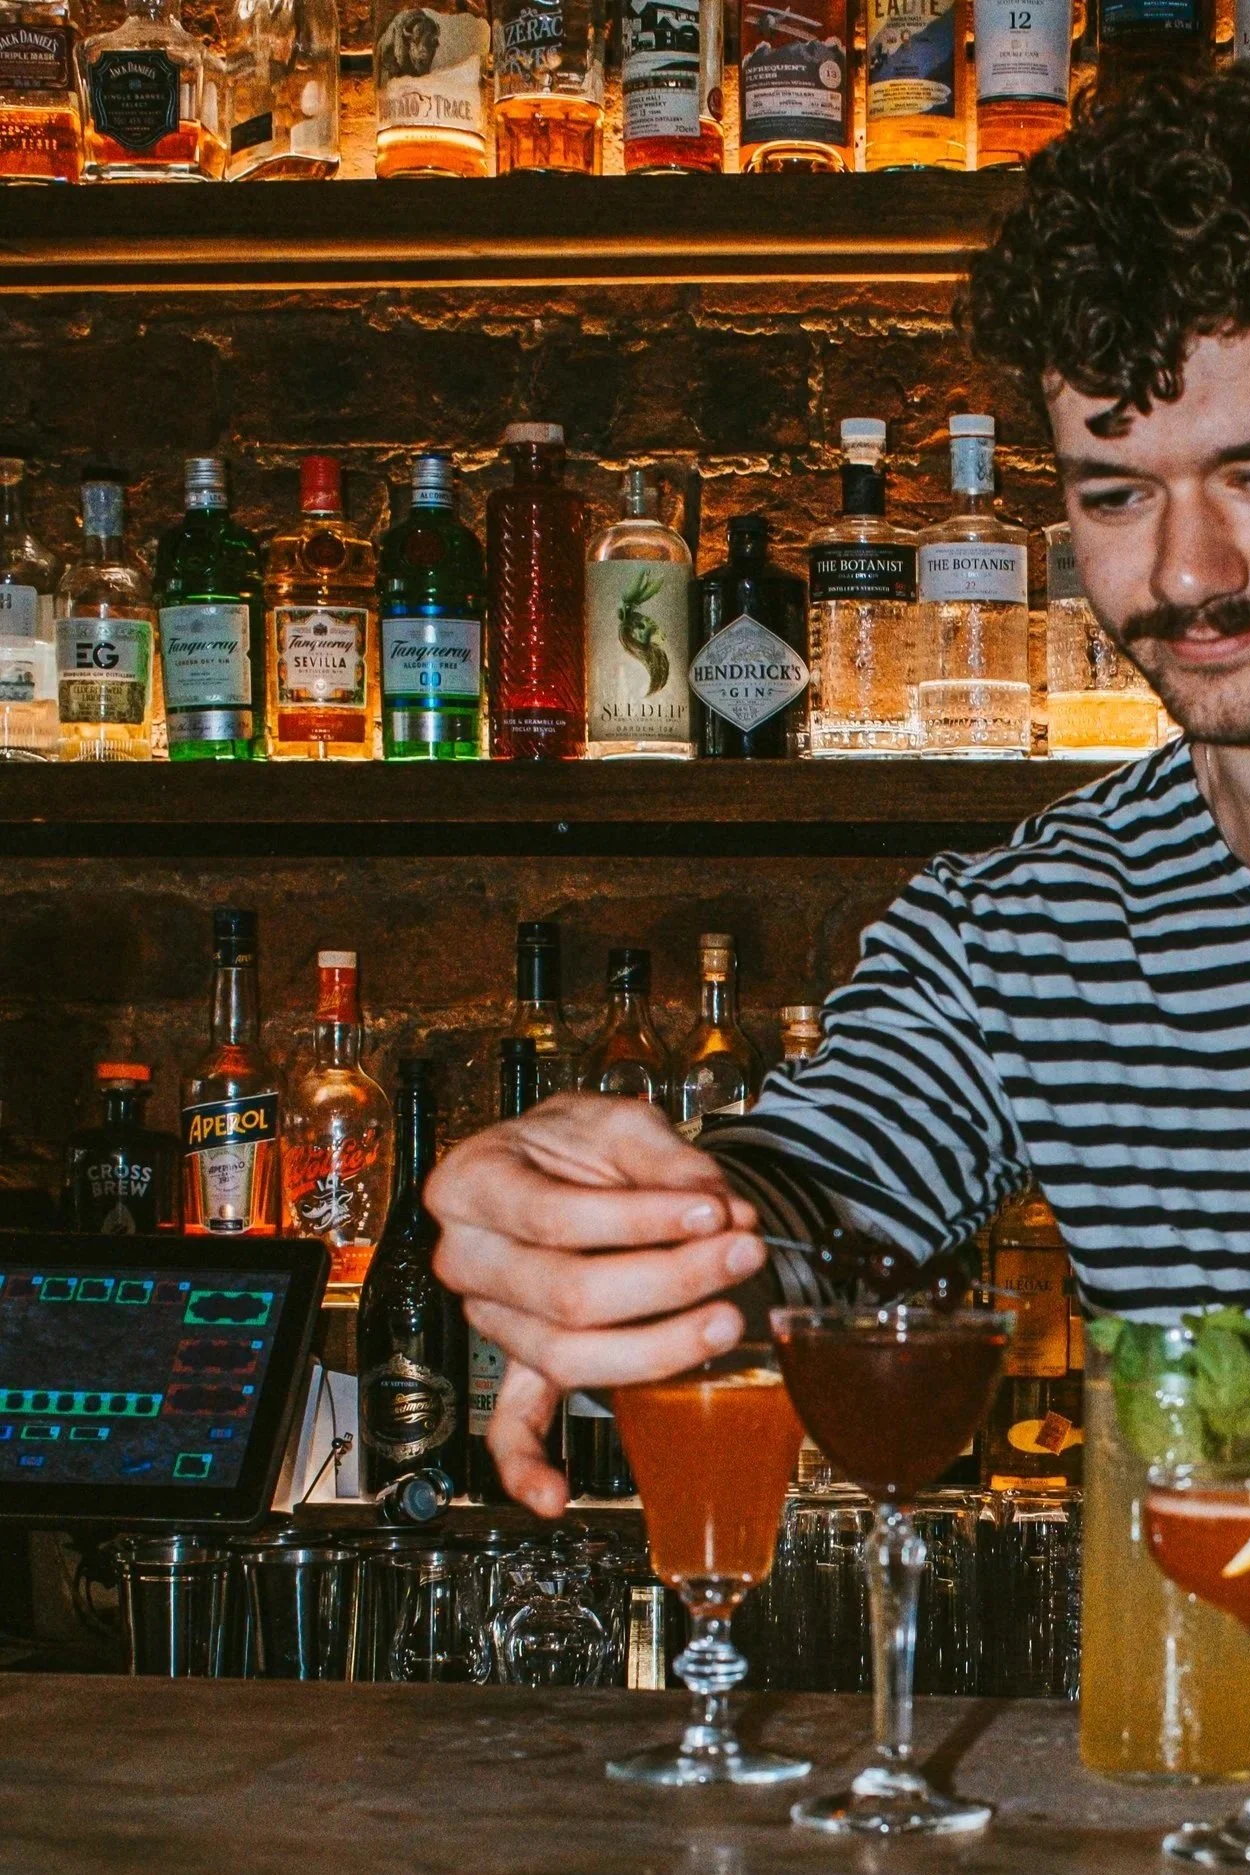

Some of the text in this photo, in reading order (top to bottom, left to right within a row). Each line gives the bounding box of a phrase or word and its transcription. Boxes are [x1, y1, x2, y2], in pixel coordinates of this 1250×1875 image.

[1009, 11, 1032, 29] 12
[0, 29, 59, 53] ACK DANIEL'S
[31, 52, 55, 60] MASH
[433, 94, 474, 120] TRACE
[816, 559, 904, 573] THE BOTANIST
[928, 557, 1016, 572] THE BOTANIST
[168, 637, 239, 656] Tanqueray
[288, 634, 354, 653] Tanqueray
[390, 640, 472, 663] Tanqueray
[76, 642, 119, 669] EG
[294, 656, 347, 669] SEVILLA
[693, 664, 802, 682] HENDRICK'S
[729, 687, 765, 698] GIN
[601, 703, 687, 722] SEEDLIP
[616, 725, 655, 733] GARDEN
[188, 1108, 269, 1145] APEROL
[87, 1163, 153, 1182] CROSS
[91, 1180, 148, 1198] BREW
